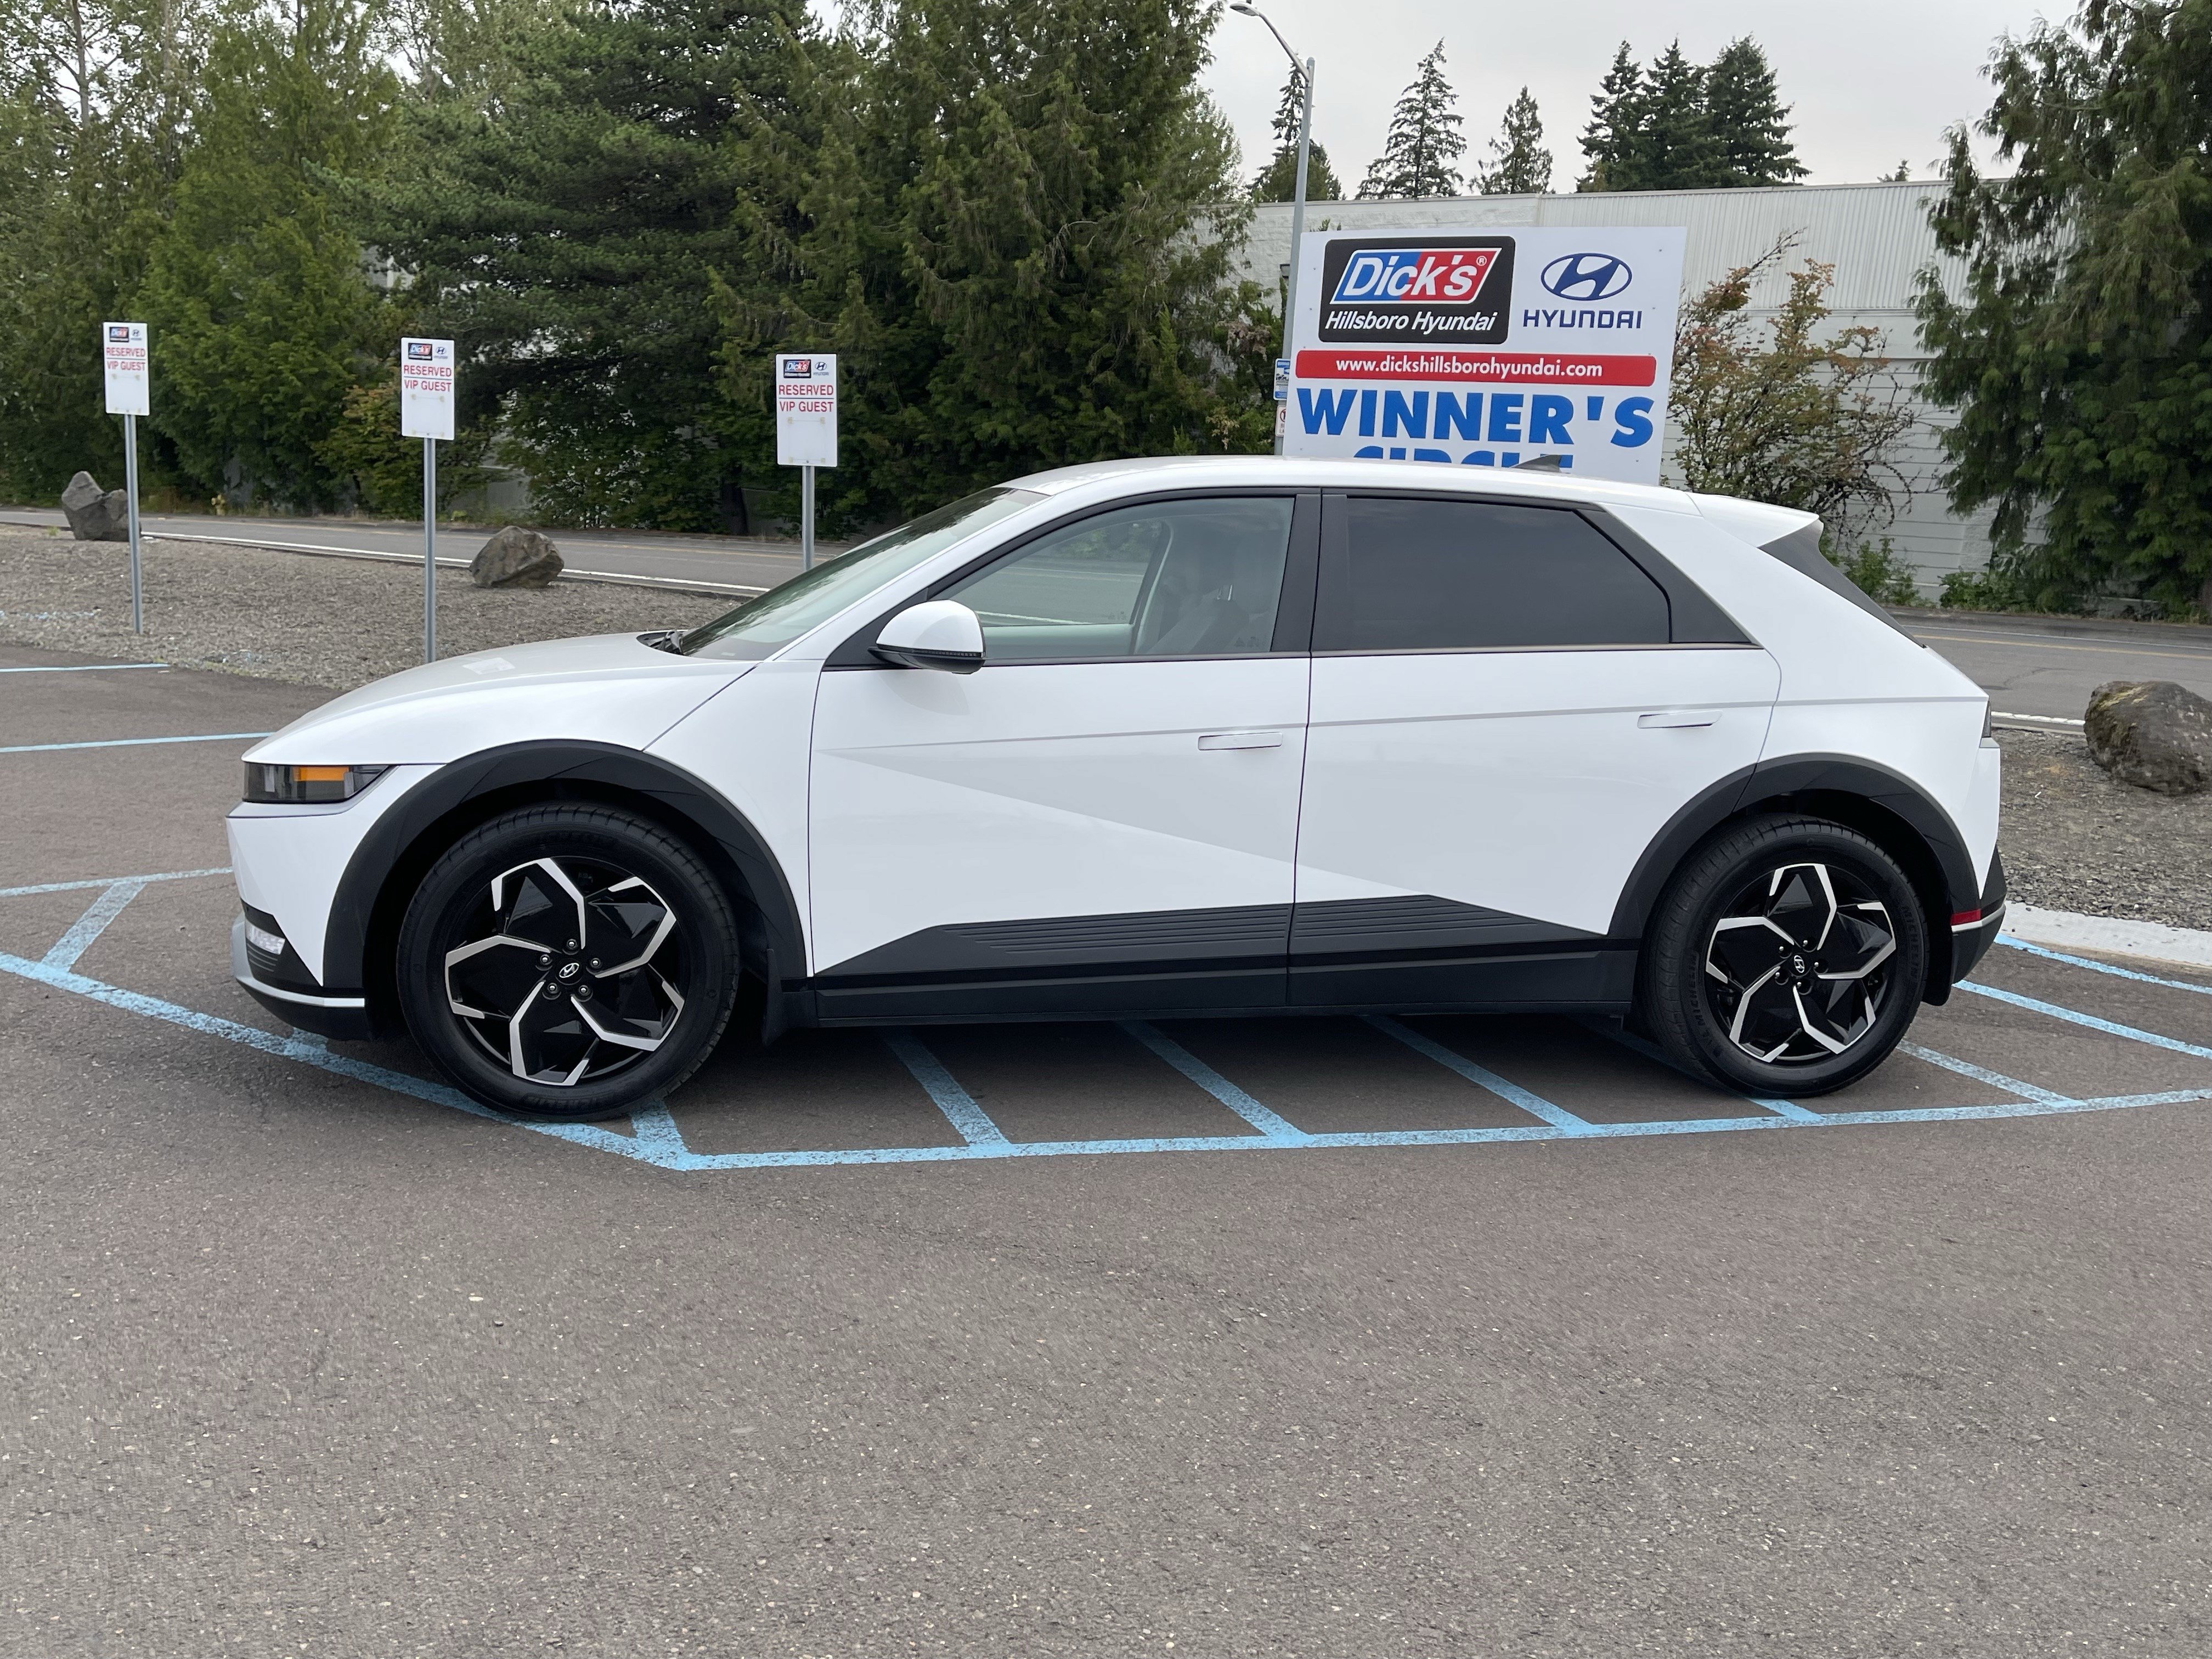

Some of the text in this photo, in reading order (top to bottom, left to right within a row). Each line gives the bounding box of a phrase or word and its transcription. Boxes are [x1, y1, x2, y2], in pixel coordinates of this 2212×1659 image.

[1325, 311, 1498, 335] Hillsboro Hyundai
[1523, 309, 1643, 329] HYUNDAI
[106, 347, 145, 357] RESERVED
[107, 361, 145, 370] VIP GUEST
[404, 365, 452, 377] RESERVED
[1336, 355, 1602, 379] www.dickshillsborohyundai.com
[404, 380, 452, 392] VIP GUEST
[778, 385, 833, 395] RESERVED
[780, 401, 833, 412] VIP GUEST
[1296, 388, 1655, 448] WINNER'S
